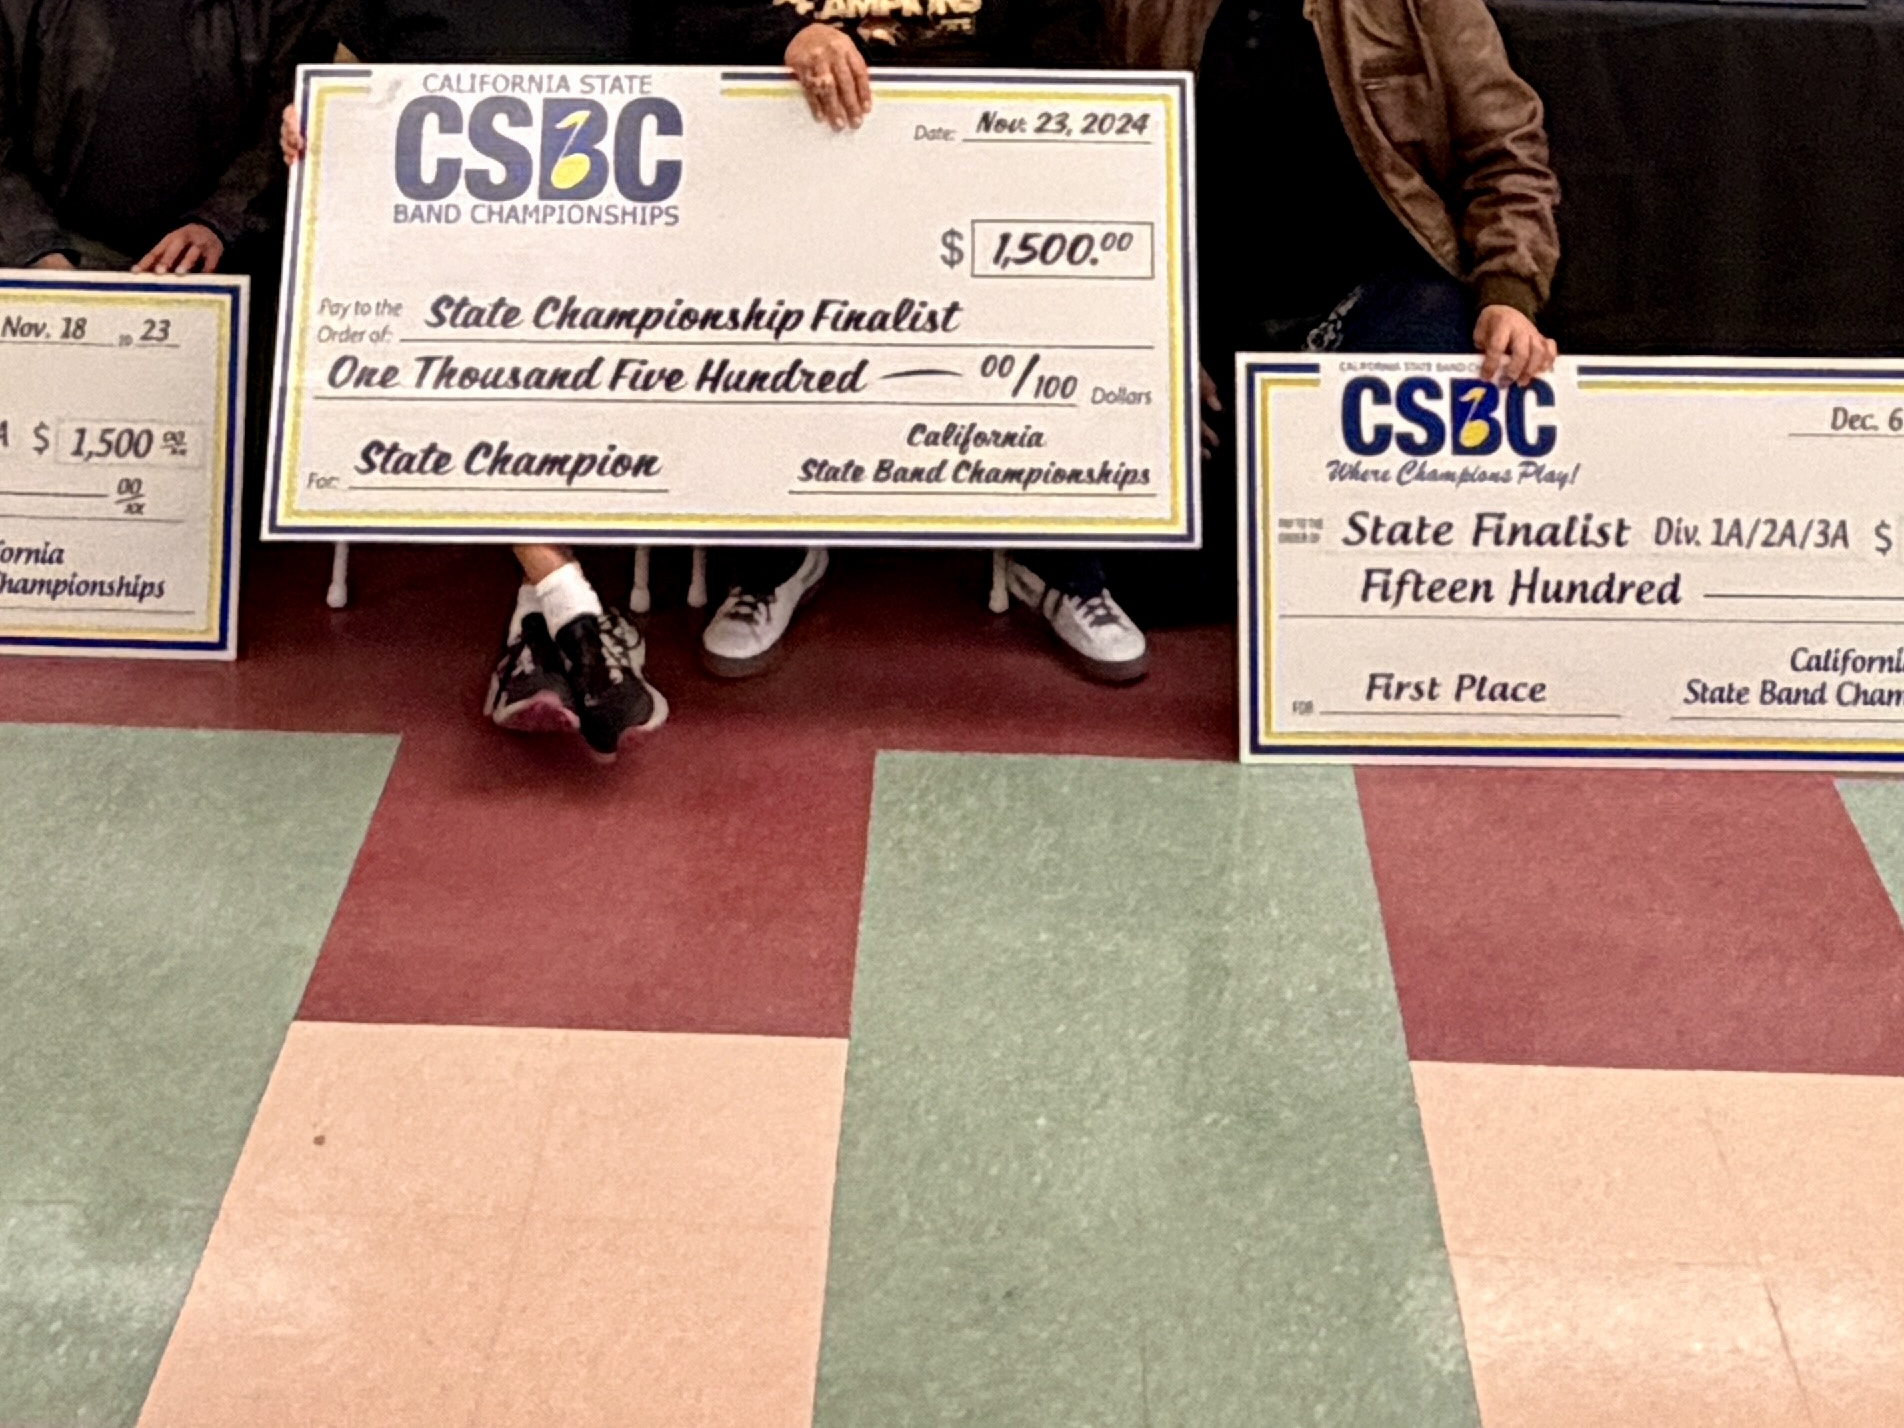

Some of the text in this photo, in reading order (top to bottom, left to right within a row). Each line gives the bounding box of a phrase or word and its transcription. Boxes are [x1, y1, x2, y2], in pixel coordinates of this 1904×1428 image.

[423, 73, 652, 95] CALIFORNIA STATE
[914, 126, 955, 141] Date:
[1034, 112, 1072, 136] 23,
[1081, 113, 1150, 135] 2024
[396, 95, 683, 203] CSBC
[394, 204, 679, 226] BAND CHAMPIONSHIPS
[941, 228, 964, 269] $
[318, 298, 403, 319] Pay to the
[424, 294, 964, 339] State Championship Finalist
[1, 316, 51, 339] Nov.
[59, 317, 87, 339] 18
[140, 319, 171, 341] 23
[317, 326, 365, 343] Order
[327, 354, 399, 389] One
[414, 355, 605, 391] Thousand
[607, 358, 686, 391] Five
[694, 358, 869, 393] Hundred
[1090, 386, 1152, 406] Dollars
[1342, 375, 1557, 457] CSBC
[1831, 406, 1879, 431] Dec.
[1889, 408, 1904, 431] 6
[32, 421, 51, 455] $
[70, 427, 154, 461] 1,500
[907, 422, 1045, 455] California
[354, 440, 662, 485] State Champion
[797, 458, 1151, 491] State Band Championships
[1326, 459, 1581, 490] Where Champions Play!
[1343, 510, 1454, 547] State
[1472, 513, 1631, 547] Finalist
[1653, 516, 1701, 546] Div.
[1710, 518, 1850, 550] 1A/2A/3A
[1874, 520, 1893, 555] $
[1361, 567, 1682, 609] Fifteen Hundred
[1365, 673, 1547, 703] First Place
[1683, 679, 1751, 707] State
[1757, 680, 1828, 708] Band
